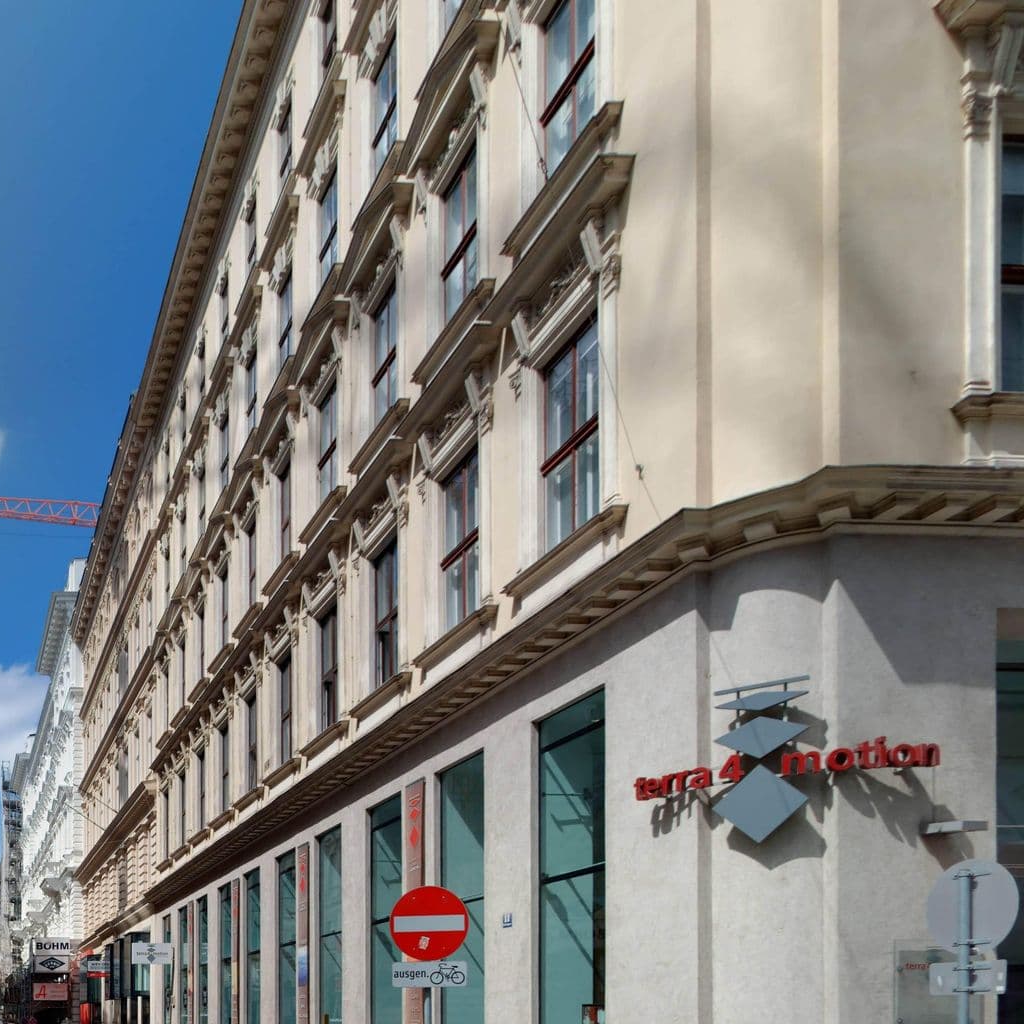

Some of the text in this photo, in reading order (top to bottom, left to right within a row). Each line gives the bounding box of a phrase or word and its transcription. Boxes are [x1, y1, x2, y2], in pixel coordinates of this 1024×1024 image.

[633, 766, 712, 801] terra
[781, 736, 941, 777] motion
[393, 970, 429, 980] ausgen.
